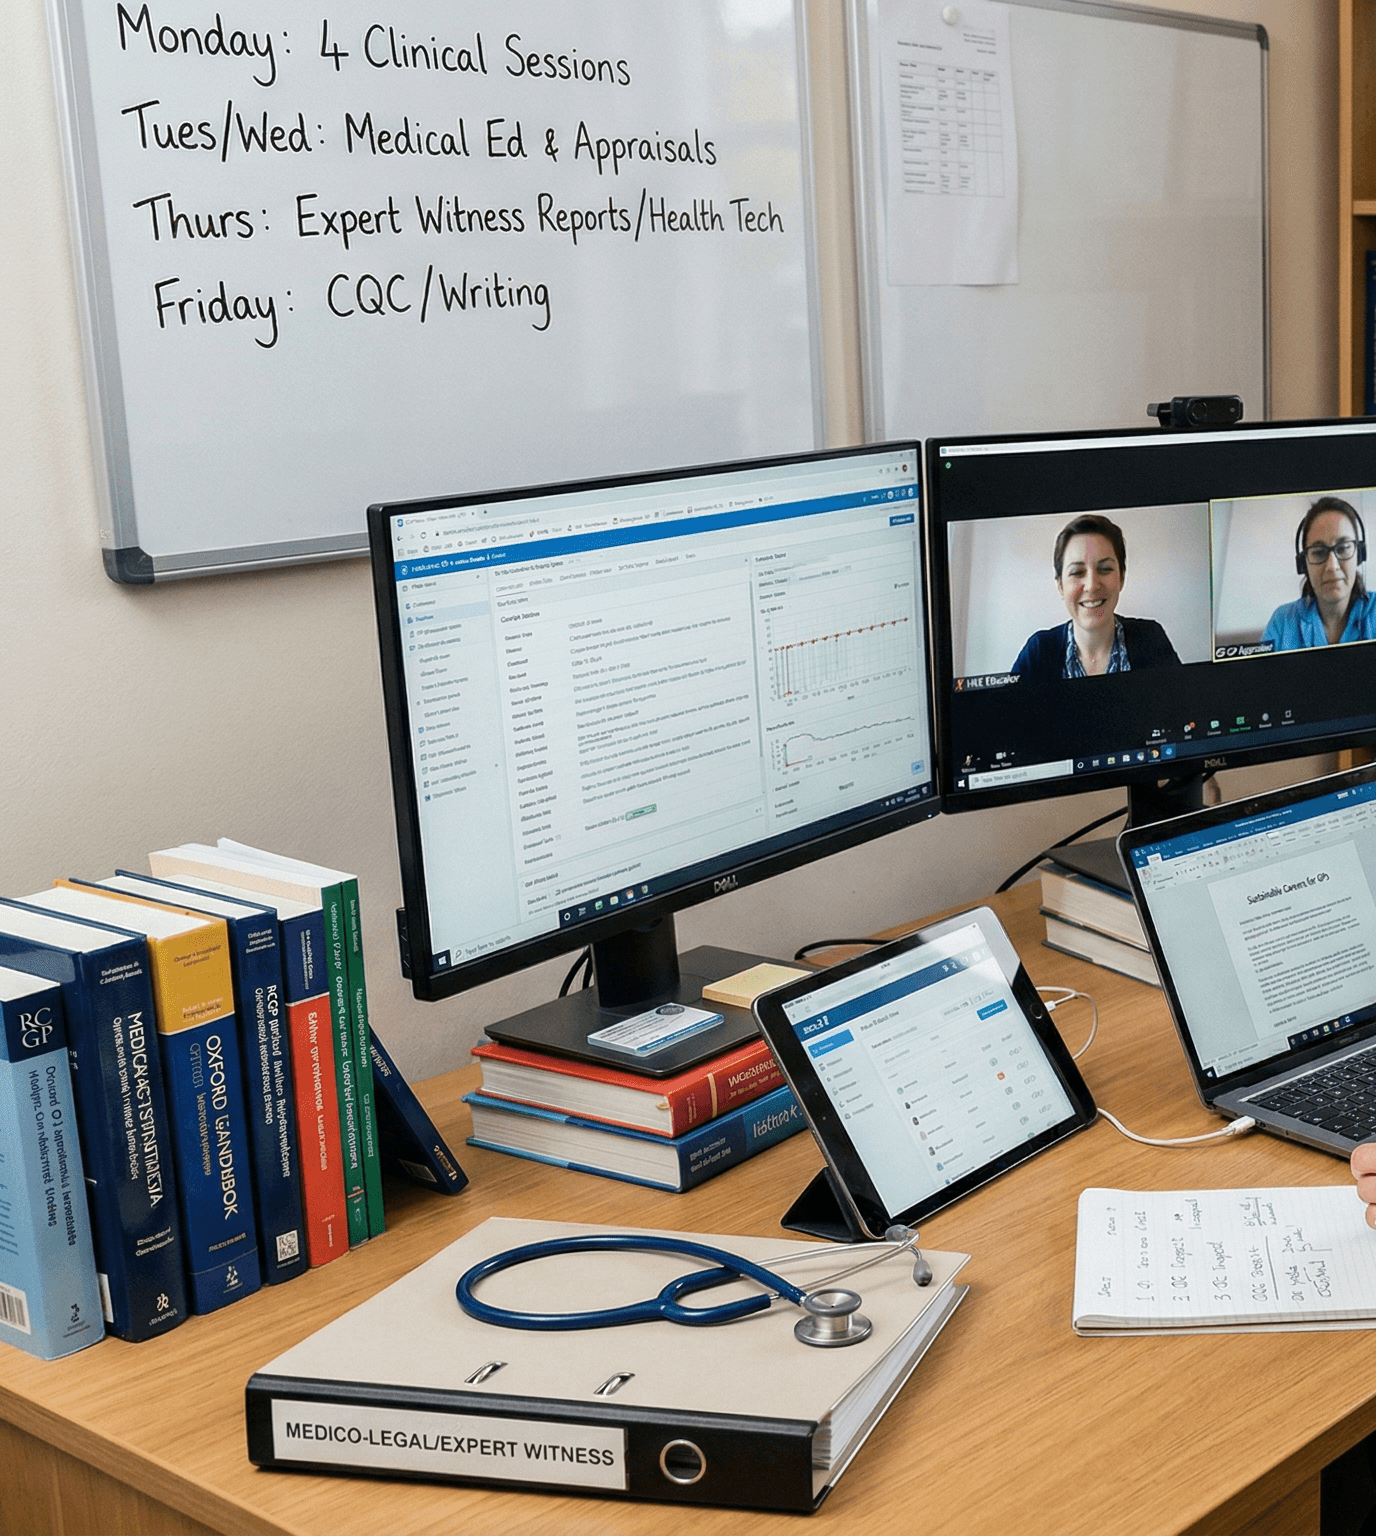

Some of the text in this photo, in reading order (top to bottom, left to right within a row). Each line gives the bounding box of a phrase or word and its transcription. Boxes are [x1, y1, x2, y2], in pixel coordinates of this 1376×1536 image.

[116, 3, 631, 87] Monday: 4 Clinical Sessions
[121, 99, 717, 176] Tues/Wed: Medical Ed & Appraisals
[132, 188, 785, 251] Thurs: Expert Witness Reports/Health Tech
[154, 277, 294, 349] Friday:
[206, 1034, 228, 1111] OXFORD
[285, 1421, 616, 1467] MEDICO-LEGAL/EXPERT WITNESS
